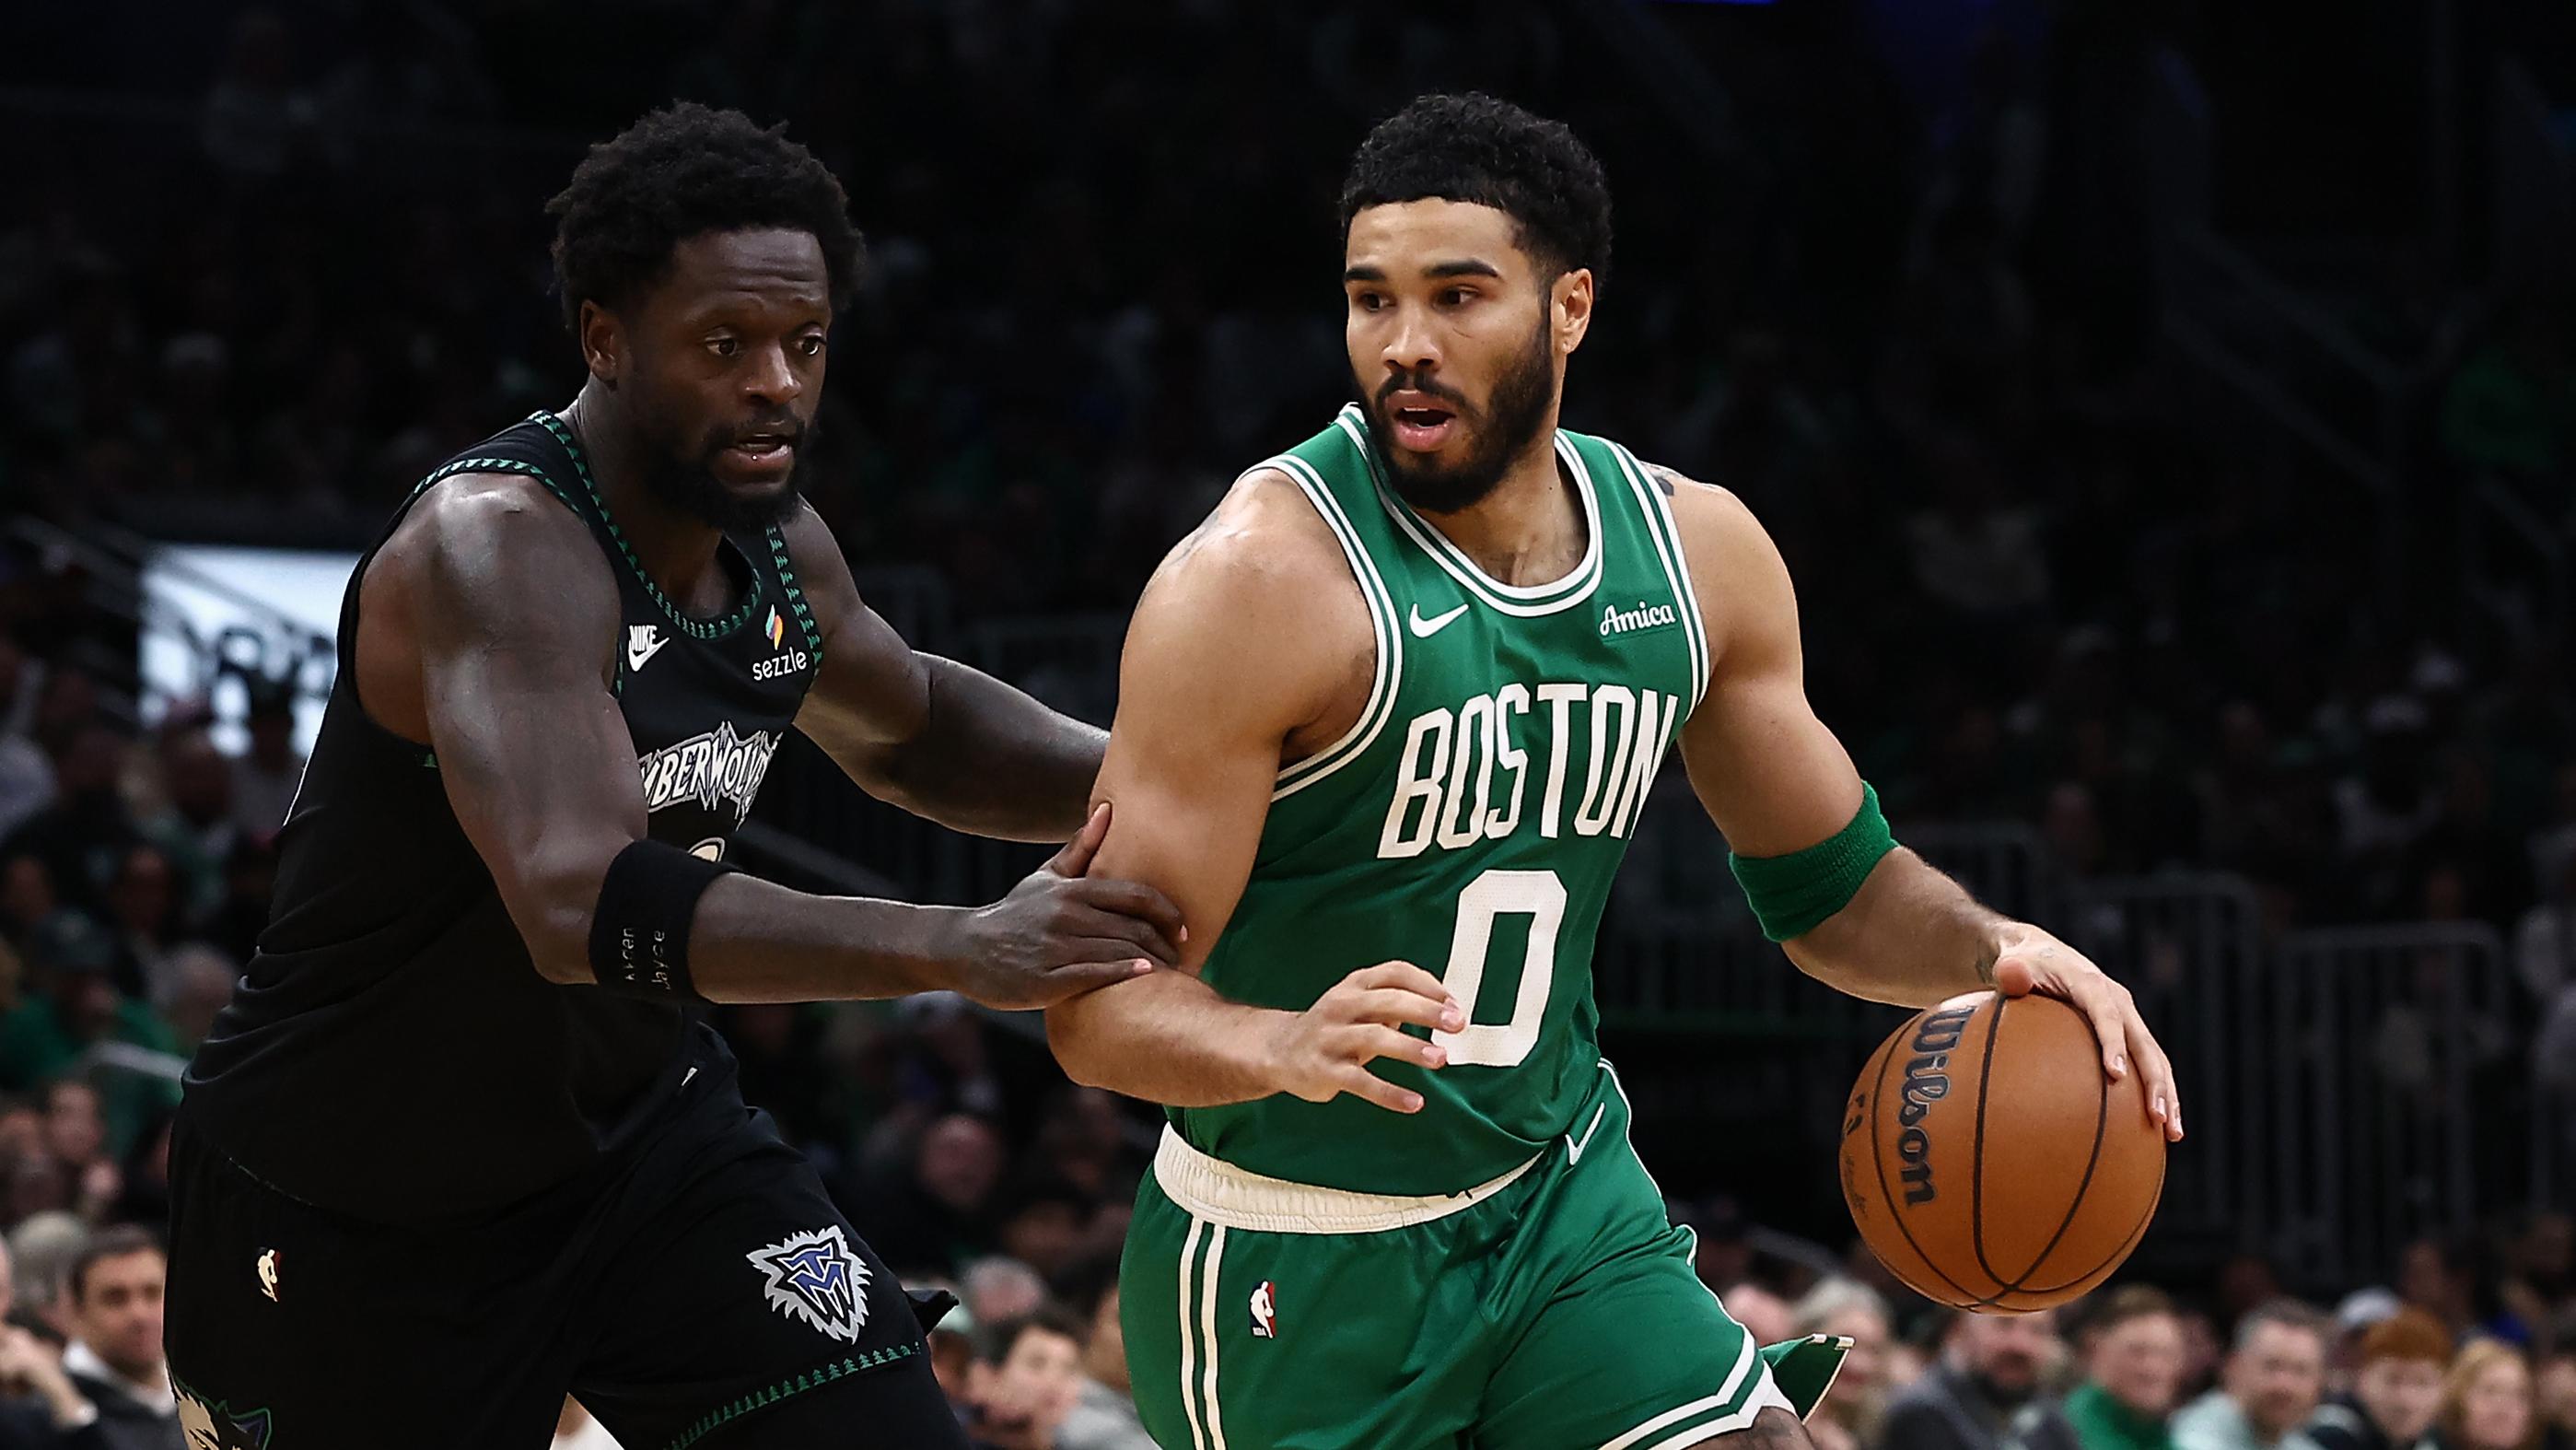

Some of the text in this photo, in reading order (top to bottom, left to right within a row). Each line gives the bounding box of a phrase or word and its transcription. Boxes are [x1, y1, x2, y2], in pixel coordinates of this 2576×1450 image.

[629, 626, 657, 651] NIKE
[752, 647, 807, 681] sezzle
[1600, 601, 1676, 636] Amica
[1377, 683, 1679, 859] BOSTON
[1430, 870, 1568, 1067] 0
[1897, 1005, 1977, 1209] Wilson
